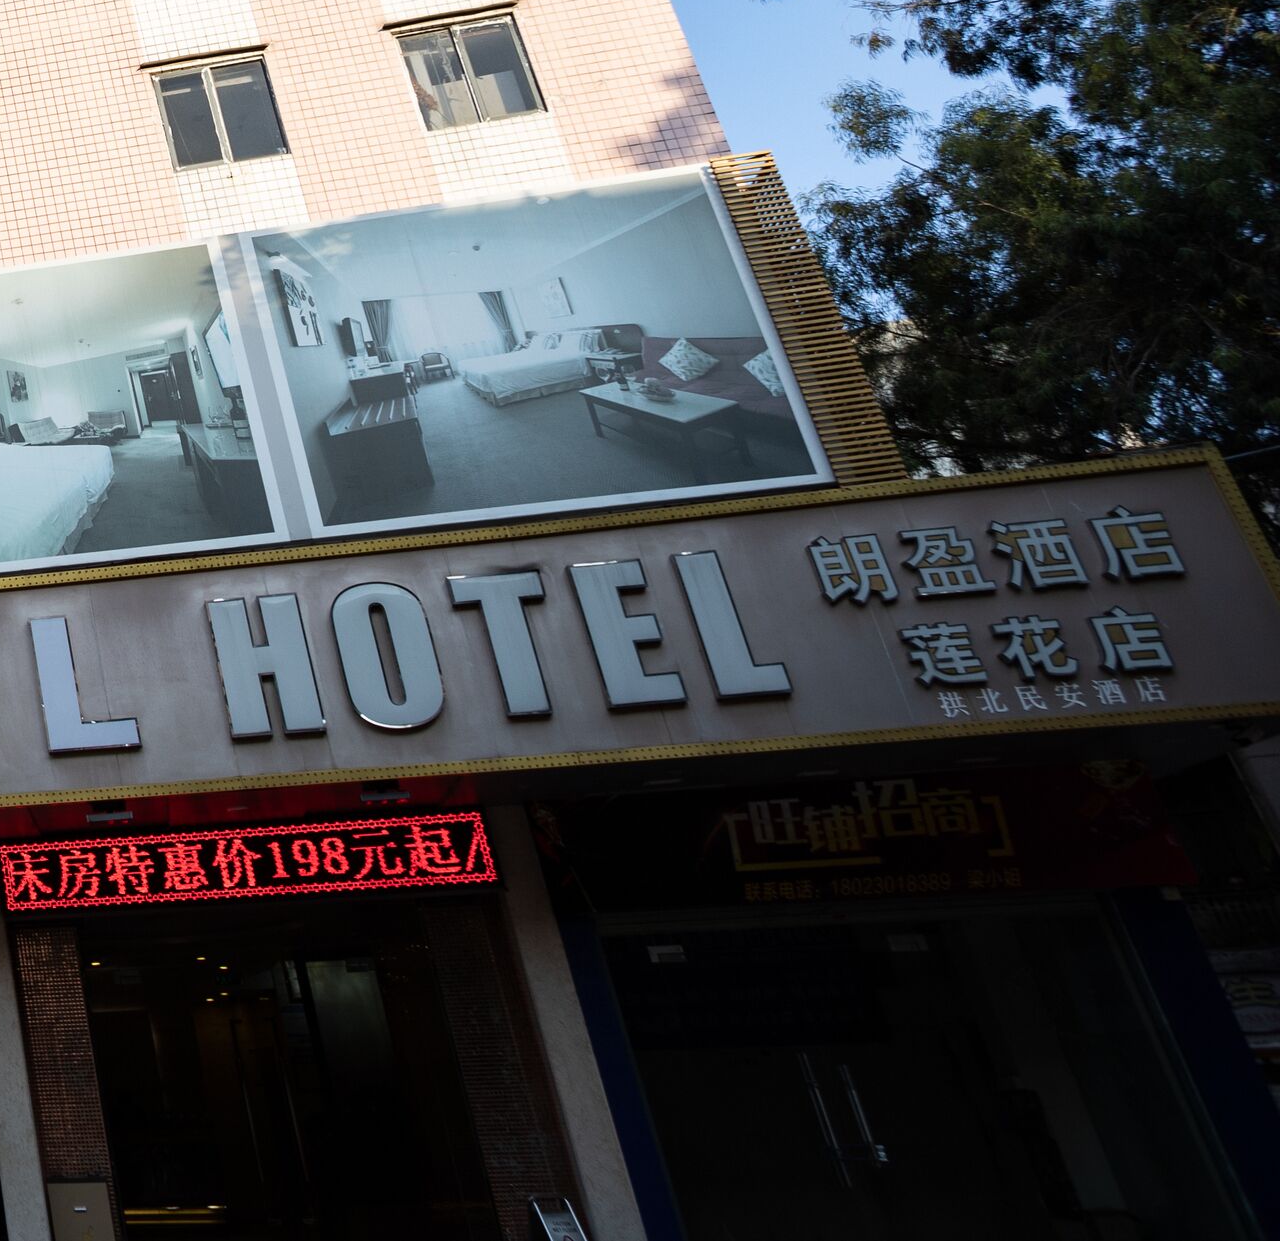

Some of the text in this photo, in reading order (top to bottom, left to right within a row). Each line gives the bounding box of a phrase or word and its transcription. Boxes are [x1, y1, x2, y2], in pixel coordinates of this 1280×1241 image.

[807, 504, 1187, 607] 朗盈酒店
[28, 549, 793, 758] L HOTEL
[899, 605, 1174, 688] 莲花店
[937, 677, 1167, 719] 拱北民安酒店
[747, 778, 984, 853] 旺铺招商
[12, 823, 480, 902] 床房特惠价198元起
